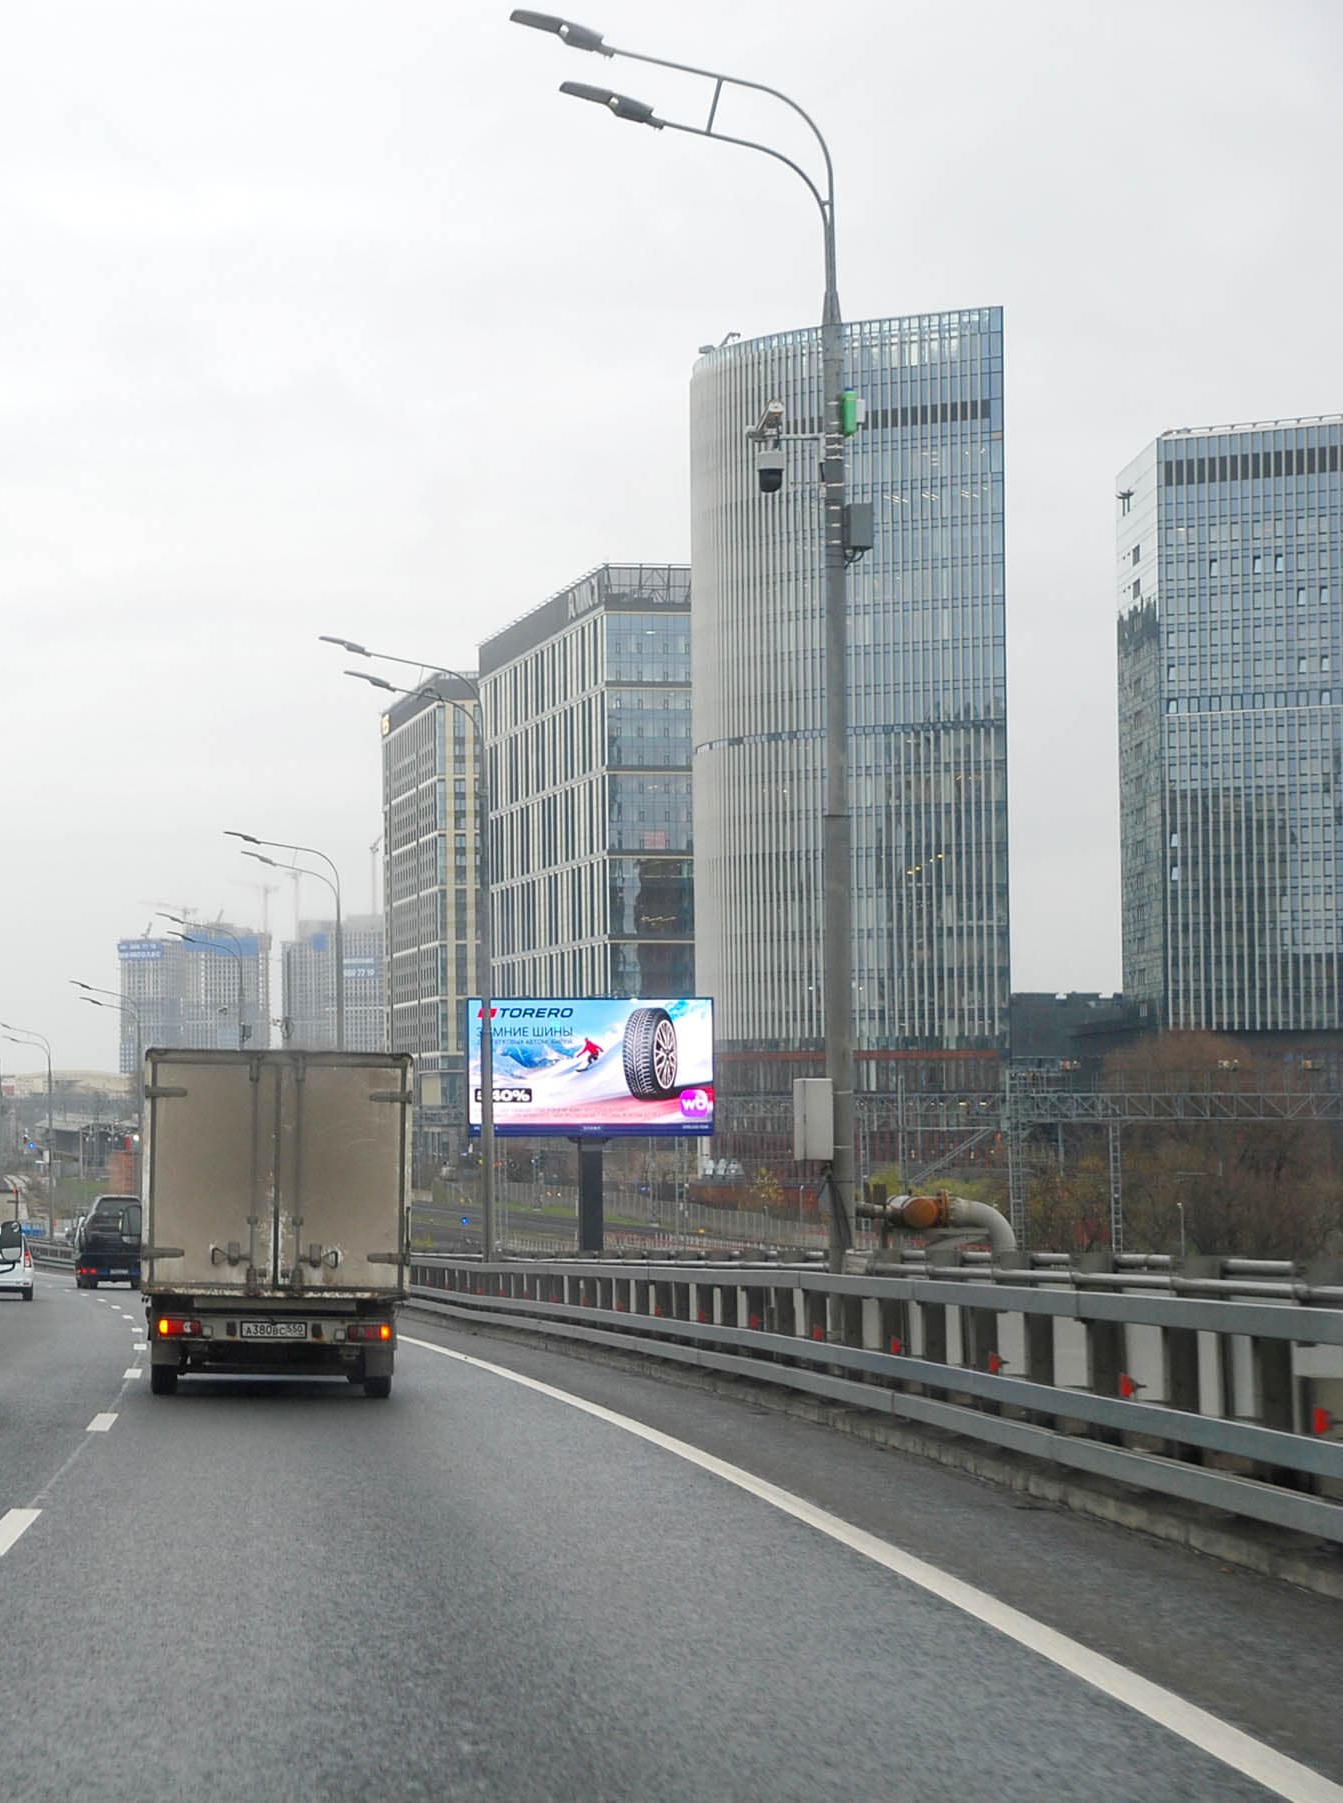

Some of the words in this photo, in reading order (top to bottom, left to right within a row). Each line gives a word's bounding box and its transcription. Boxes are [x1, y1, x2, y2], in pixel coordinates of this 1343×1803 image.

[499, 1008, 574, 1018] TORERO
[476, 1026, 529, 1037] ЗМНИЕ
[532, 1026, 573, 1037] ШИНЫ
